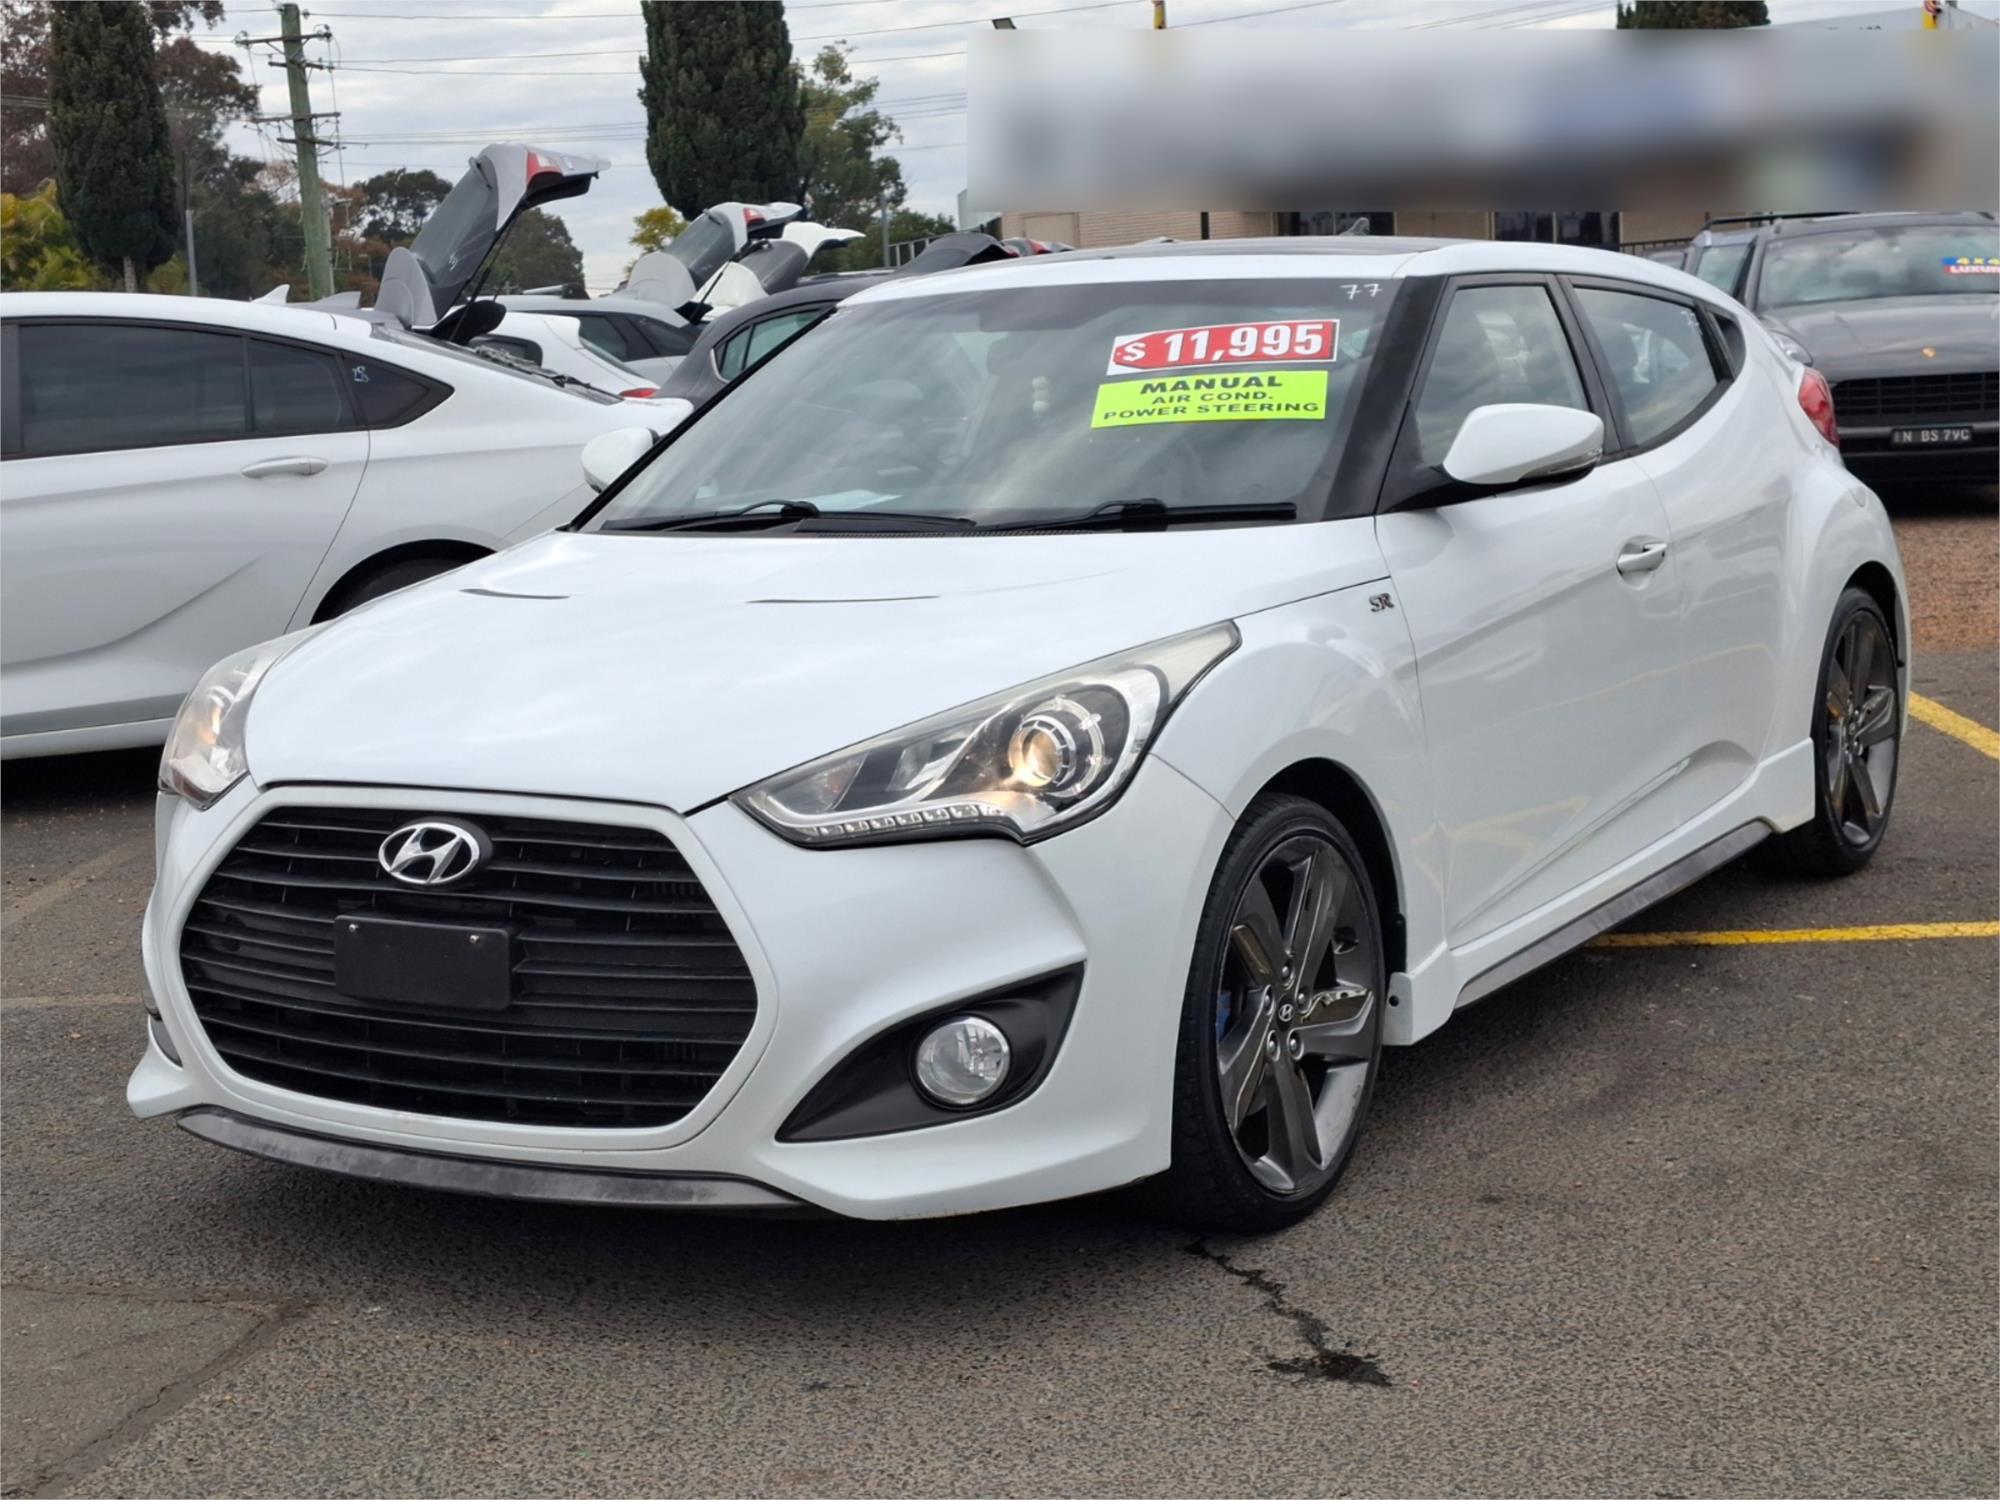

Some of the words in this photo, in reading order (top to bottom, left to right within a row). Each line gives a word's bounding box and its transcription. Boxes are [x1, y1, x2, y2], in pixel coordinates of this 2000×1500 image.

[1340, 283, 1383, 300] 77
[1164, 323, 1324, 362] 11,995
[1139, 375, 1284, 395] MANUAL
[1151, 395, 1191, 405] AIR
[1200, 391, 1274, 402] COND.
[1103, 405, 1187, 420] POWER
[1196, 402, 1320, 414] STEERING
